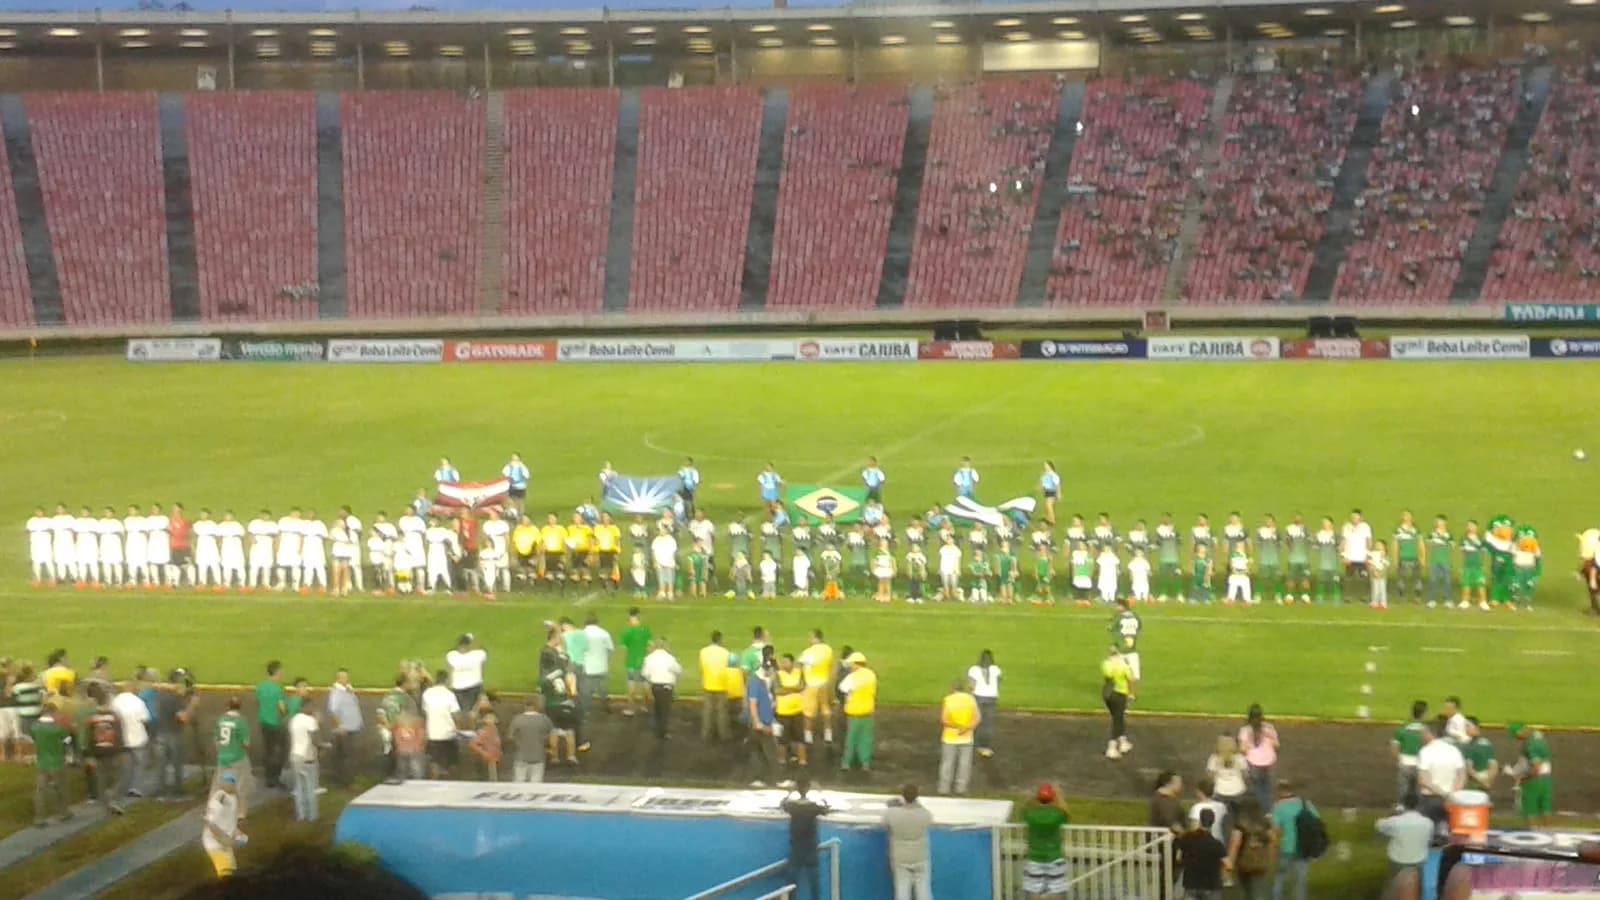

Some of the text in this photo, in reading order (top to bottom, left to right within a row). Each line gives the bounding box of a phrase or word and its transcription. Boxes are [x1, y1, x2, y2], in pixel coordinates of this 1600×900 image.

[472, 343, 545, 357] GATORADE
[1427, 339, 1528, 354] Beba Leite Cemil
